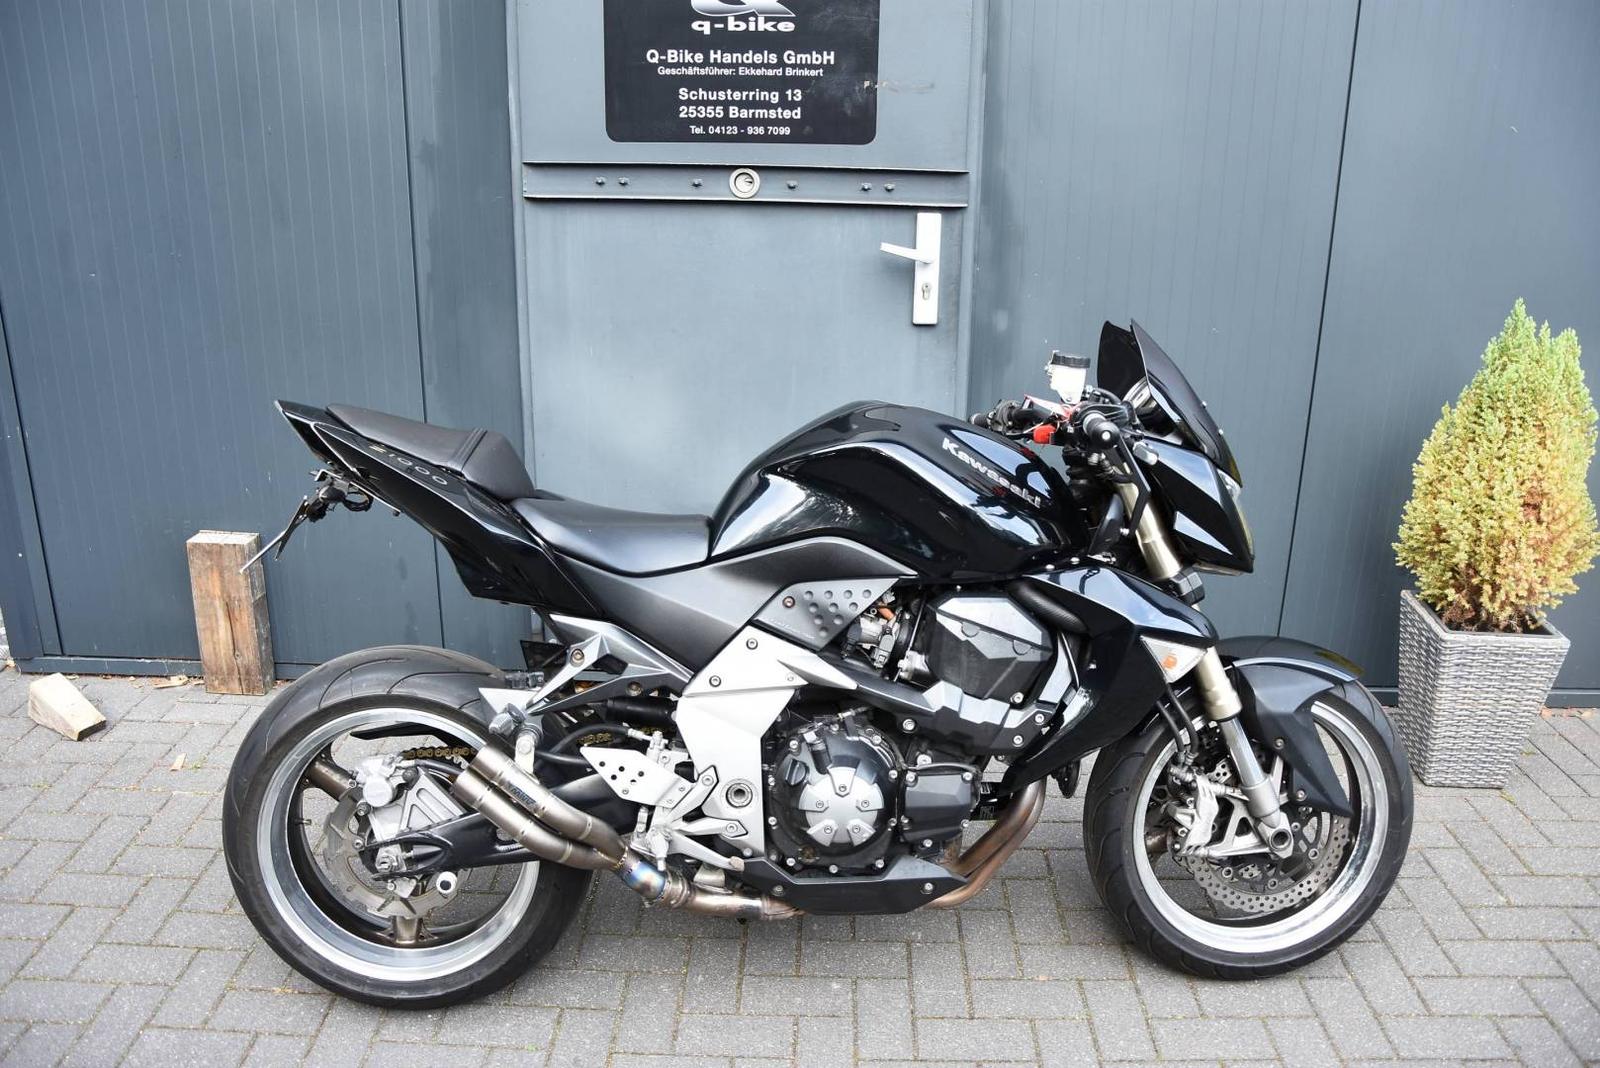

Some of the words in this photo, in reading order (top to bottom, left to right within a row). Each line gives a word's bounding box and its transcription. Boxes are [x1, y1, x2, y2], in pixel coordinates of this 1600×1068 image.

[691, 16, 796, 35] q-bike
[646, 49, 704, 64] Q-Bike
[709, 50, 778, 64] Handels
[783, 51, 835, 65] GmbH
[657, 66, 736, 77] Geschäftsführer:
[738, 67, 783, 77] Ekkehard
[785, 68, 824, 77] Brinkert
[678, 87, 780, 103] Schusterring
[785, 90, 802, 102] 13
[678, 106, 724, 119] 25355
[729, 106, 802, 120] Barmsted
[689, 125, 706, 135] Tel.
[708, 126, 739, 135] 04123
[747, 126, 765, 136] 936
[767, 126, 791, 136] 7099
[942, 437, 1041, 508] Kawasaki
